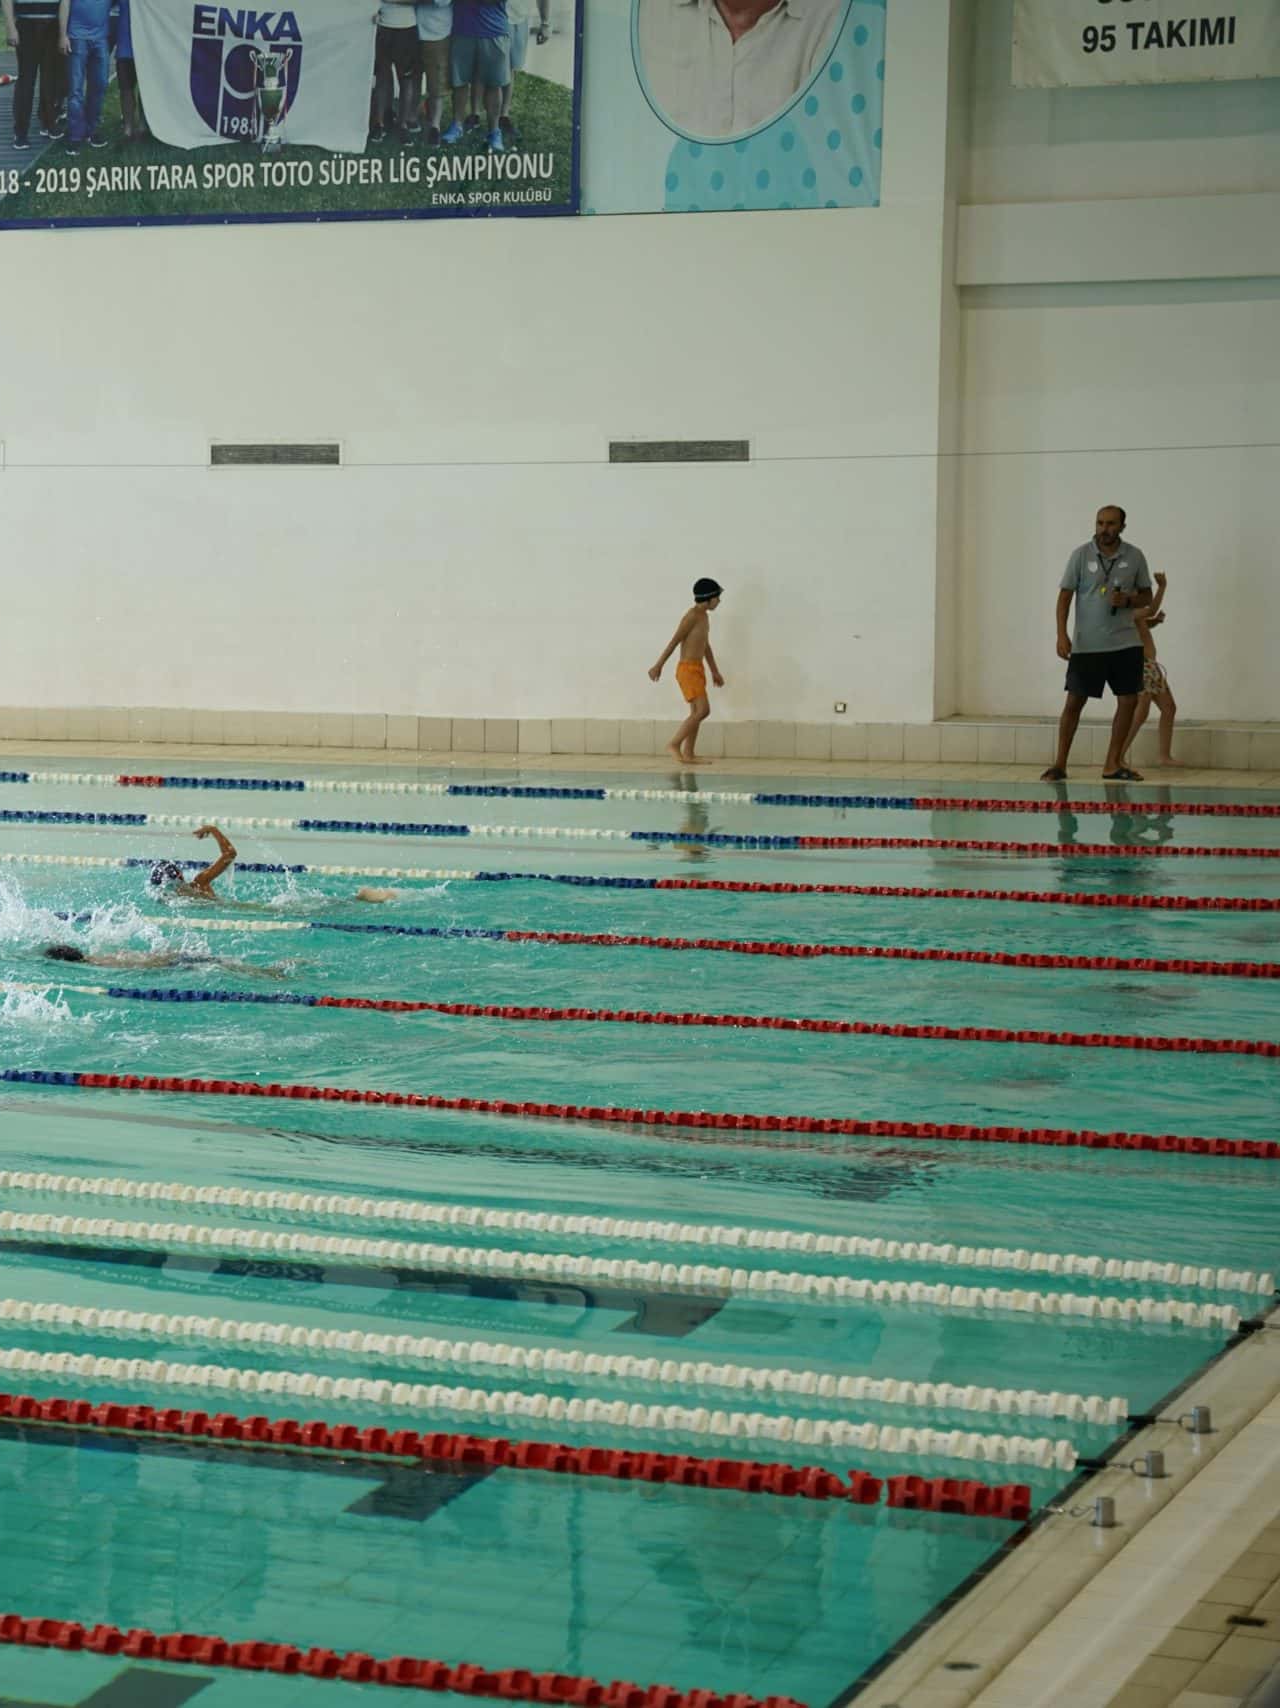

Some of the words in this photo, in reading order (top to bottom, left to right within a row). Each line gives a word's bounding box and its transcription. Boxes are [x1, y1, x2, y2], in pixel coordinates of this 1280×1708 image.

[193, 4, 303, 42] ENKA
[1082, 25, 1116, 53] 95
[1126, 16, 1236, 50] TAKIMI
[36, 167, 81, 193] 2019
[86, 165, 142, 198] ŞARIK
[147, 164, 198, 190] TARA
[203, 162, 255, 188] SPOR
[260, 161, 313, 187] TOTO
[319, 154, 383, 185] SÜPER
[389, 152, 421, 183] LİG
[432, 193, 465, 205] ENKA
[468, 192, 500, 204] SPOR
[503, 188, 552, 202] KULÜBÜ
